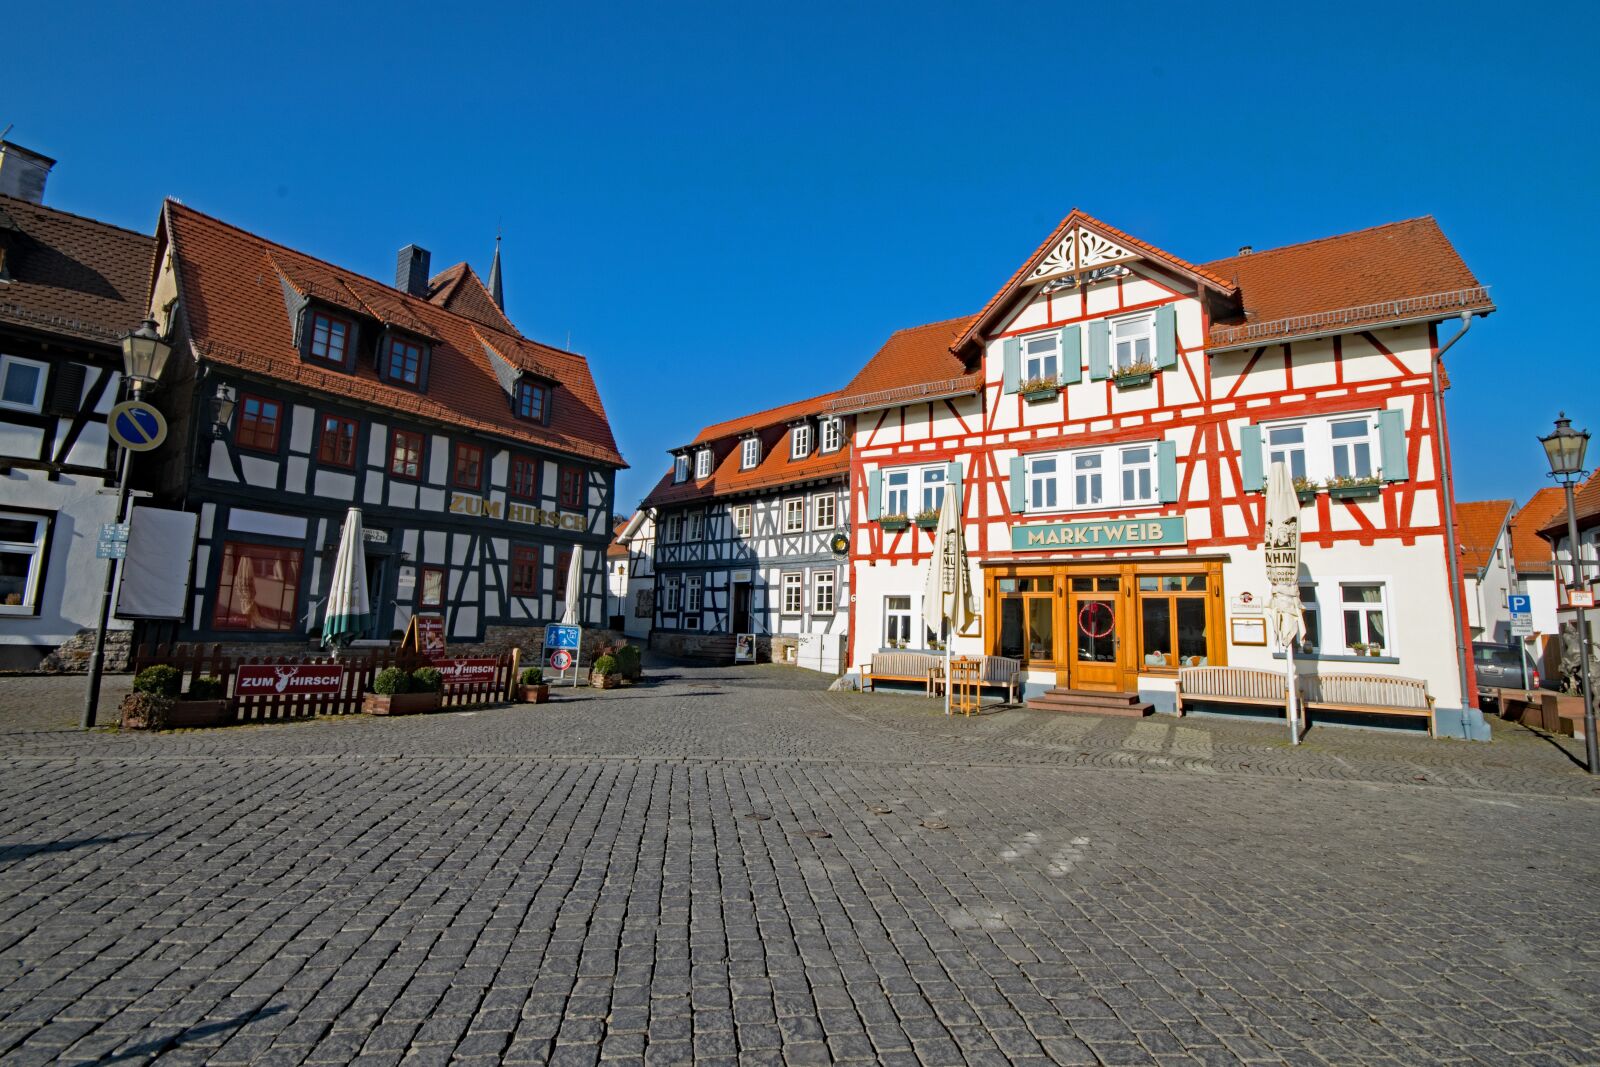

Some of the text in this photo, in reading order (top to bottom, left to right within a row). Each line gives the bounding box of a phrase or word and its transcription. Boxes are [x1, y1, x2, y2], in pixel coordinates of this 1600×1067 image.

[449, 493, 587, 532] ZUM HIRSCH
[1028, 523, 1164, 545] MARKTWEIB
[1513, 597, 1526, 611] P
[435, 665, 494, 675] ZUM HIRSCH
[241, 676, 340, 687] ZUM HIRSCH
